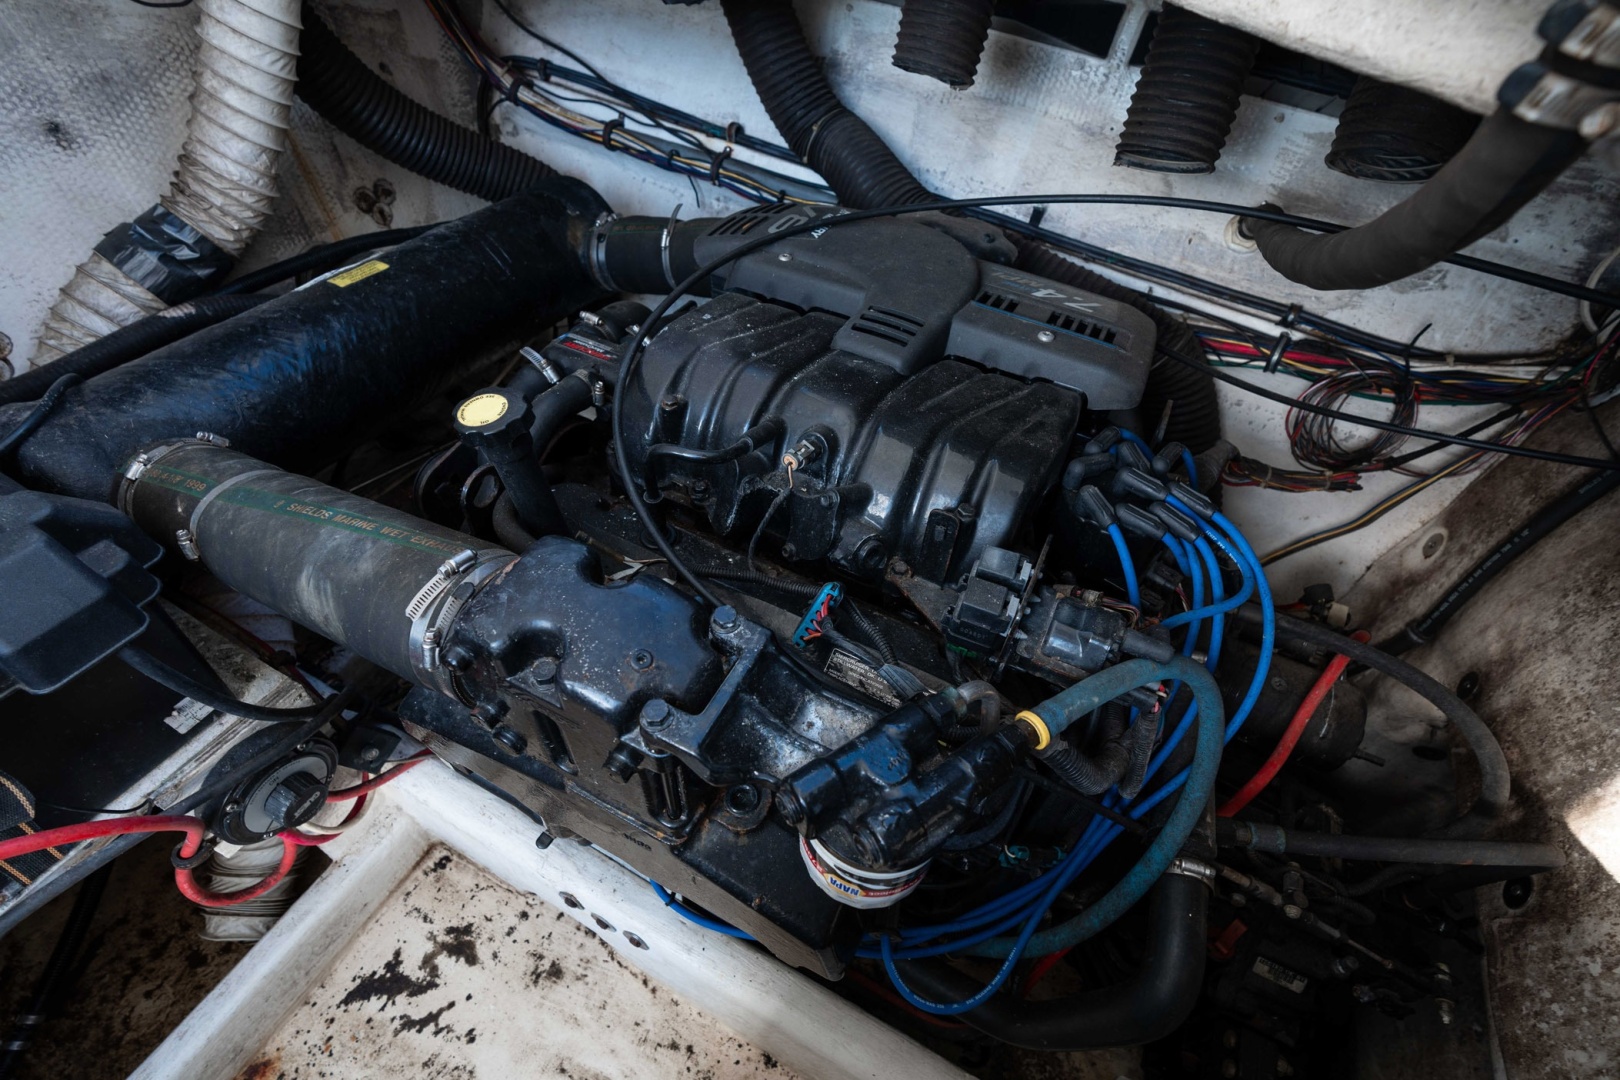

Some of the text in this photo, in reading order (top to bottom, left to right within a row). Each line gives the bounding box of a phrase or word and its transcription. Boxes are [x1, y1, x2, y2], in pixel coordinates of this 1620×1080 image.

[1031, 288, 1102, 313] 7.4
[184, 479, 206, 491] 1999
[333, 514, 378, 531] MARINE
[380, 526, 409, 539] WET
[411, 535, 467, 554] EXHAUS
[295, 790, 322, 819] GUEST
[829, 876, 859, 896] NAPA
